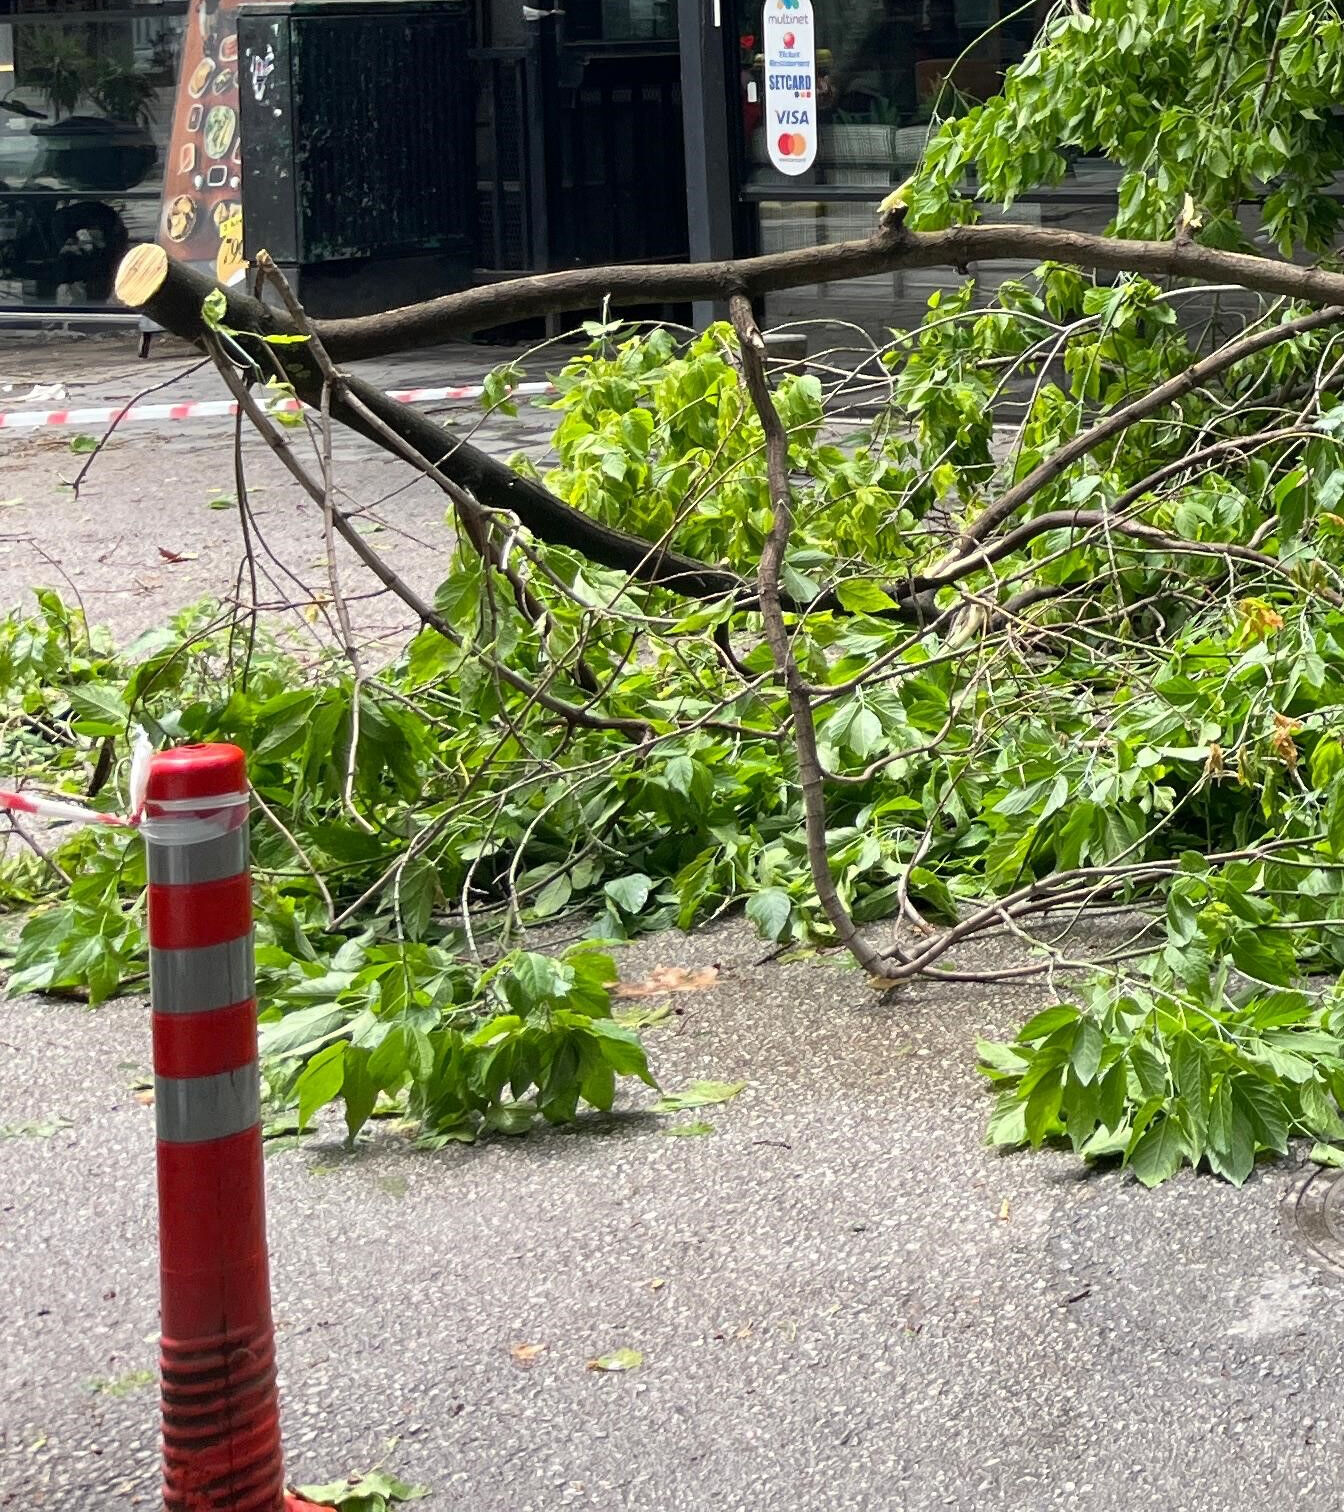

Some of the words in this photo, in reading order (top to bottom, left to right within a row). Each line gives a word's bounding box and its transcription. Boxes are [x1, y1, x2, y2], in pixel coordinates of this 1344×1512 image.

[768, 14, 809, 25] multinet
[769, 74, 812, 91] SETCARD
[775, 109, 810, 126] VISA
